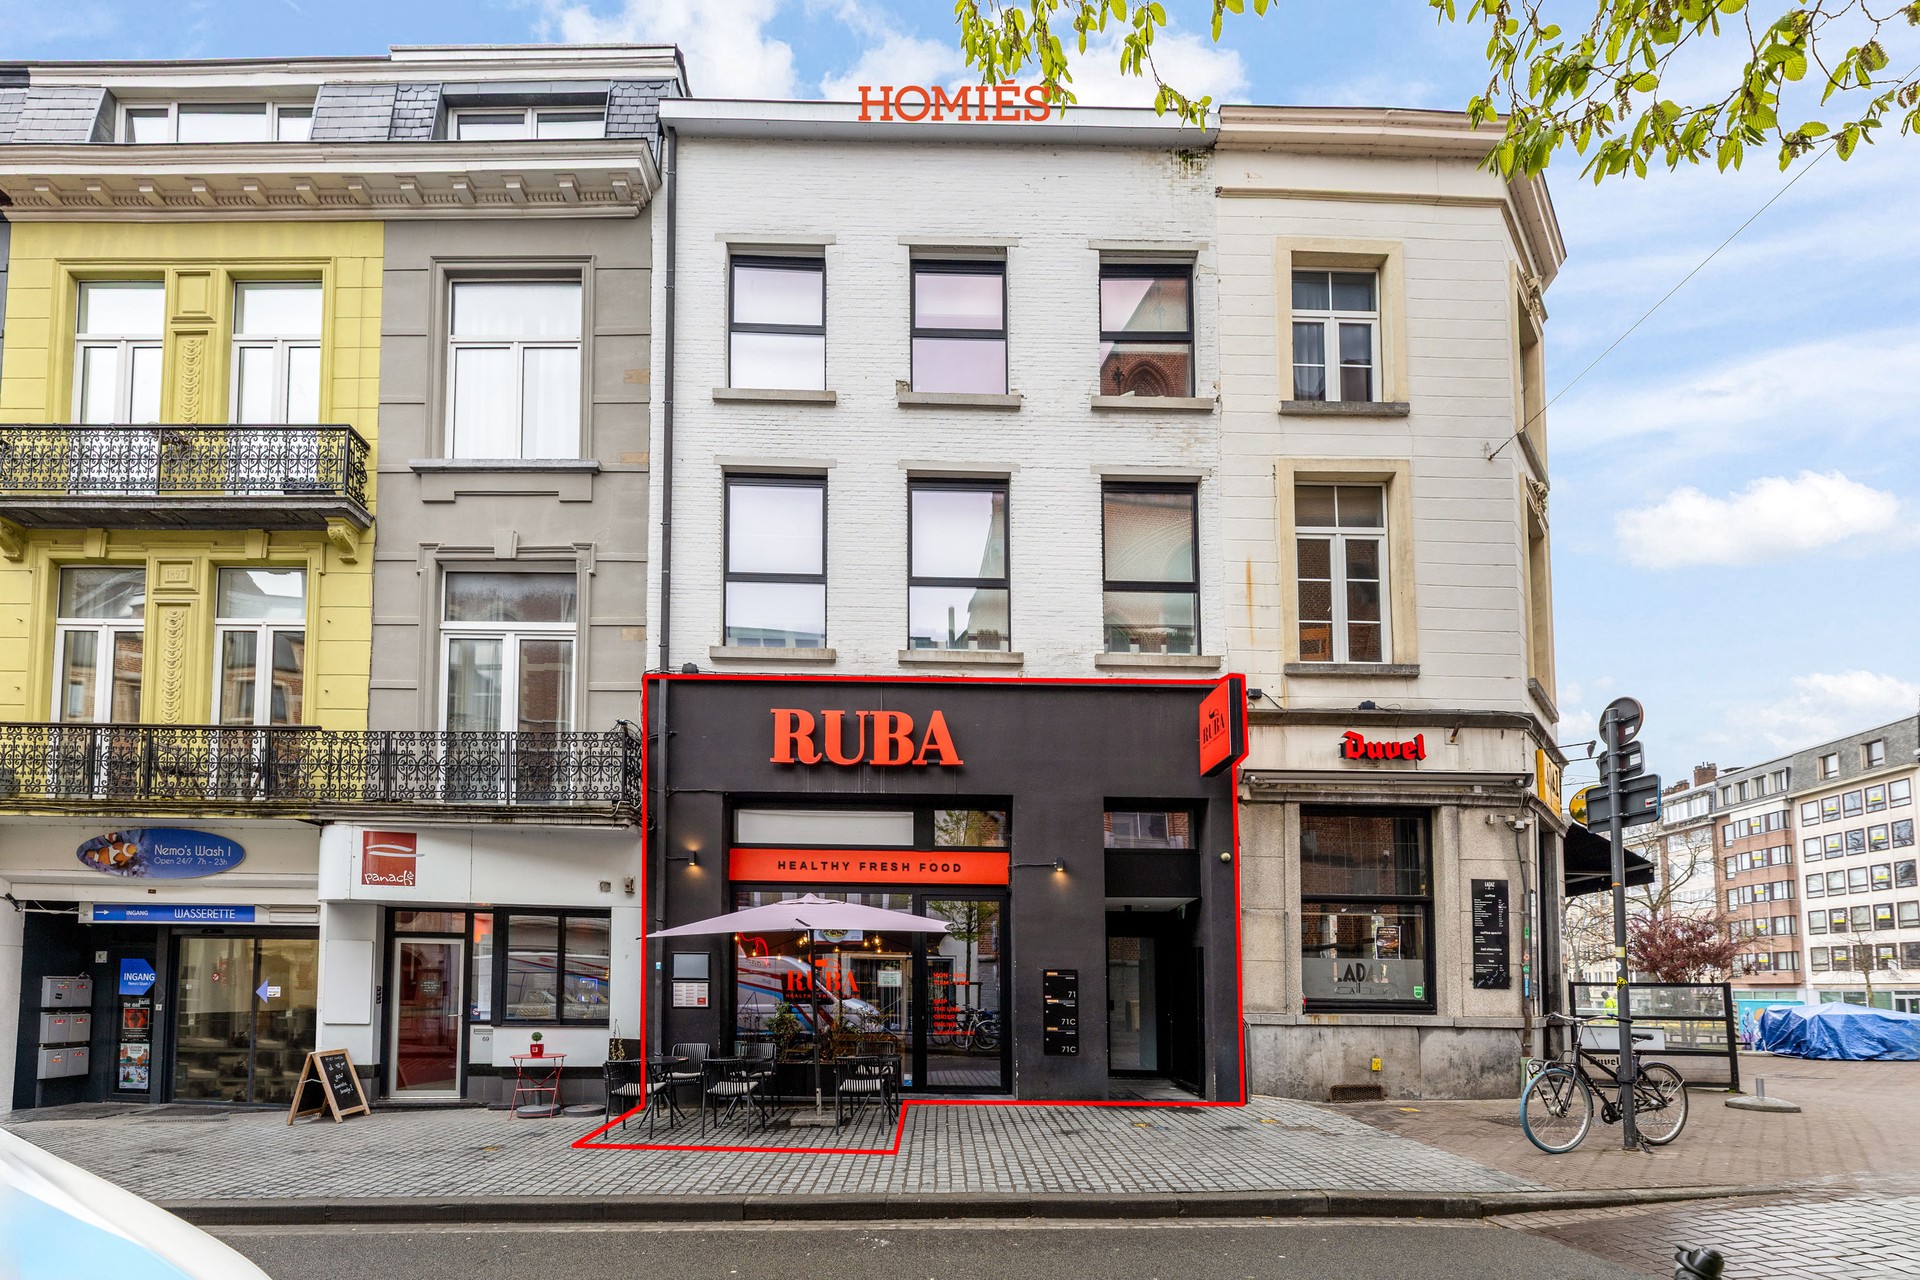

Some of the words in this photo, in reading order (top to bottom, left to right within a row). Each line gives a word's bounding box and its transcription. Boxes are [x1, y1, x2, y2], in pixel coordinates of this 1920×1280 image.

[167, 569, 186, 579] 1897
[1202, 713, 1225, 744] RUBA
[770, 708, 964, 766] RUBA
[1341, 730, 1427, 761] Duvel
[154, 844, 192, 856] Nemo's
[194, 845, 224, 857] Wash
[153, 856, 175, 865] Open
[176, 857, 193, 865] 24/7
[197, 857, 207, 865] 7h
[214, 858, 228, 866] 23h
[777, 860, 850, 871] HEALTHY
[859, 861, 910, 872] FRESH
[919, 862, 962, 873] FOOD
[174, 908, 236, 919] WASSERETTE
[123, 972, 155, 982] INGANG
[786, 969, 859, 992] RUBA
[1068, 990, 1076, 998] 71
[1061, 1018, 1076, 1026] 71C
[1061, 1045, 1077, 1053] 71C
